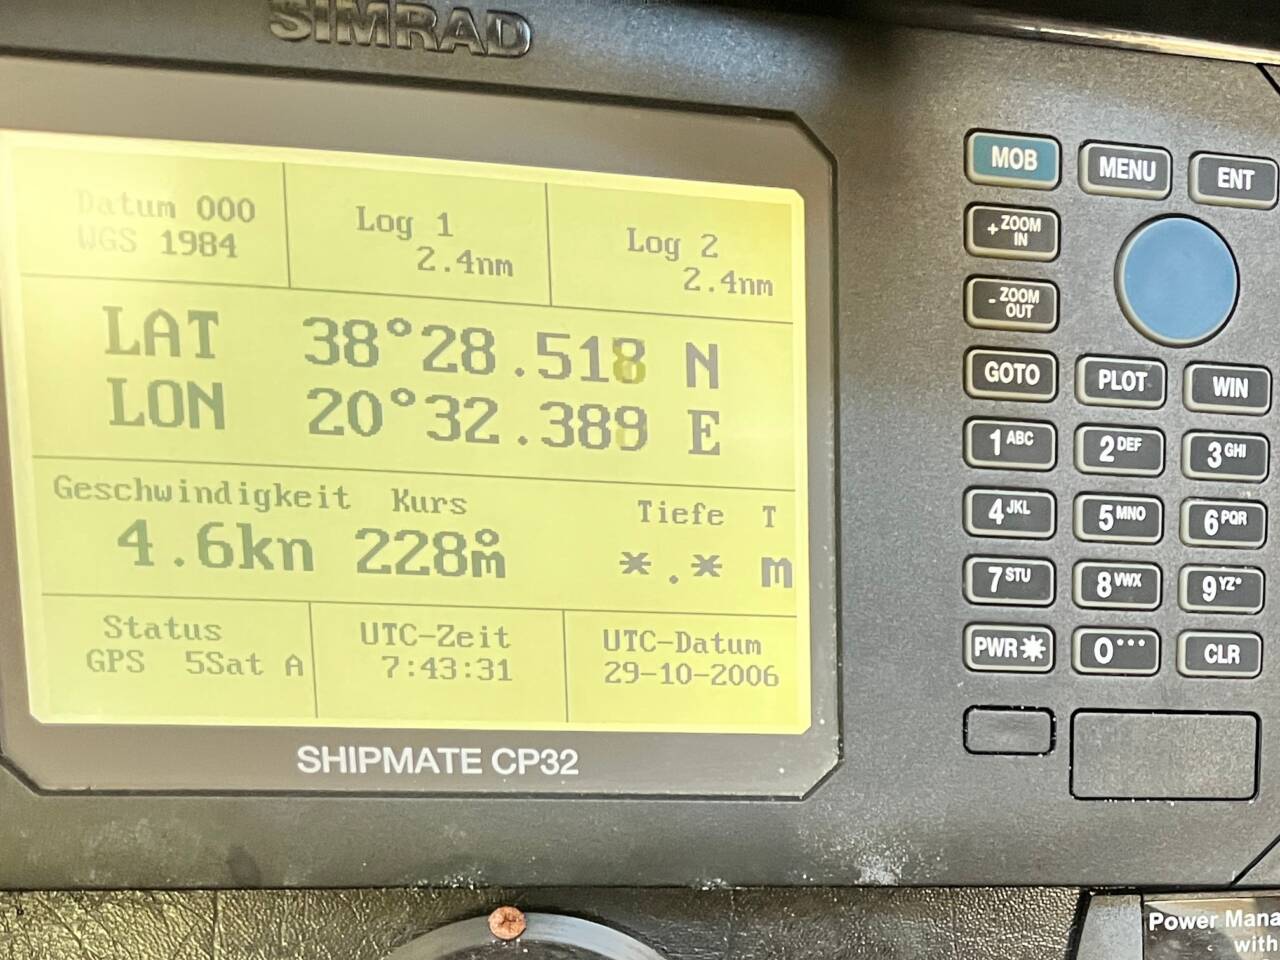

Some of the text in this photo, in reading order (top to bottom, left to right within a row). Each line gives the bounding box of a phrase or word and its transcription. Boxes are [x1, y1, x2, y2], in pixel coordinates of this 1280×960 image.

[269, 0, 531, 58] SIMRAD
[991, 145, 1038, 171] MOB
[1099, 156, 1156, 182] MENU
[1217, 167, 1255, 190] ENT
[74, 188, 256, 223] Datum 000
[356, 205, 454, 240] Log 1
[1001, 214, 1042, 233] ZOOM
[78, 225, 239, 259] WGS 1984
[627, 227, 719, 262] Log 2
[1014, 232, 1029, 247] IN
[417, 246, 514, 278] 2.4nm
[683, 266, 774, 298] 2.4nm
[1000, 286, 1039, 304] ZOOM
[1005, 303, 1034, 319] OUT
[104, 306, 720, 391] LAT 38°28.518 N
[984, 360, 1040, 386] GOTO
[1099, 369, 1148, 392] PLOT
[1212, 376, 1249, 399] WIN
[108, 377, 722, 457] LON 20°32.389 E
[1006, 431, 1034, 446] ABC
[1117, 438, 1143, 451] DEF
[1224, 443, 1247, 458] GHI
[53, 474, 725, 528] Geschwindigkeit Kurs Tiefe
[1006, 500, 1031, 515] JKL
[1116, 506, 1146, 521] MNO
[1221, 510, 1247, 526] PQR
[118, 519, 793, 588] 4.6kn m
[1005, 568, 1031, 583] STU
[1114, 573, 1142, 587] VWX
[104, 614, 222, 643] Status
[361, 622, 512, 650] UTC-Zeit
[603, 629, 763, 657] UTC-Datum
[974, 637, 1018, 659] PWR
[1094, 637, 1114, 664] 0
[1204, 644, 1240, 665] CLR
[86, 649, 305, 678] GPS 5Sat A
[382, 655, 514, 683] 7:43:31
[604, 659, 780, 688] 29-10-2006
[297, 745, 579, 776] SHIPMATE CP32
[1149, 911, 1217, 931] Power
[1234, 935, 1278, 953] with
